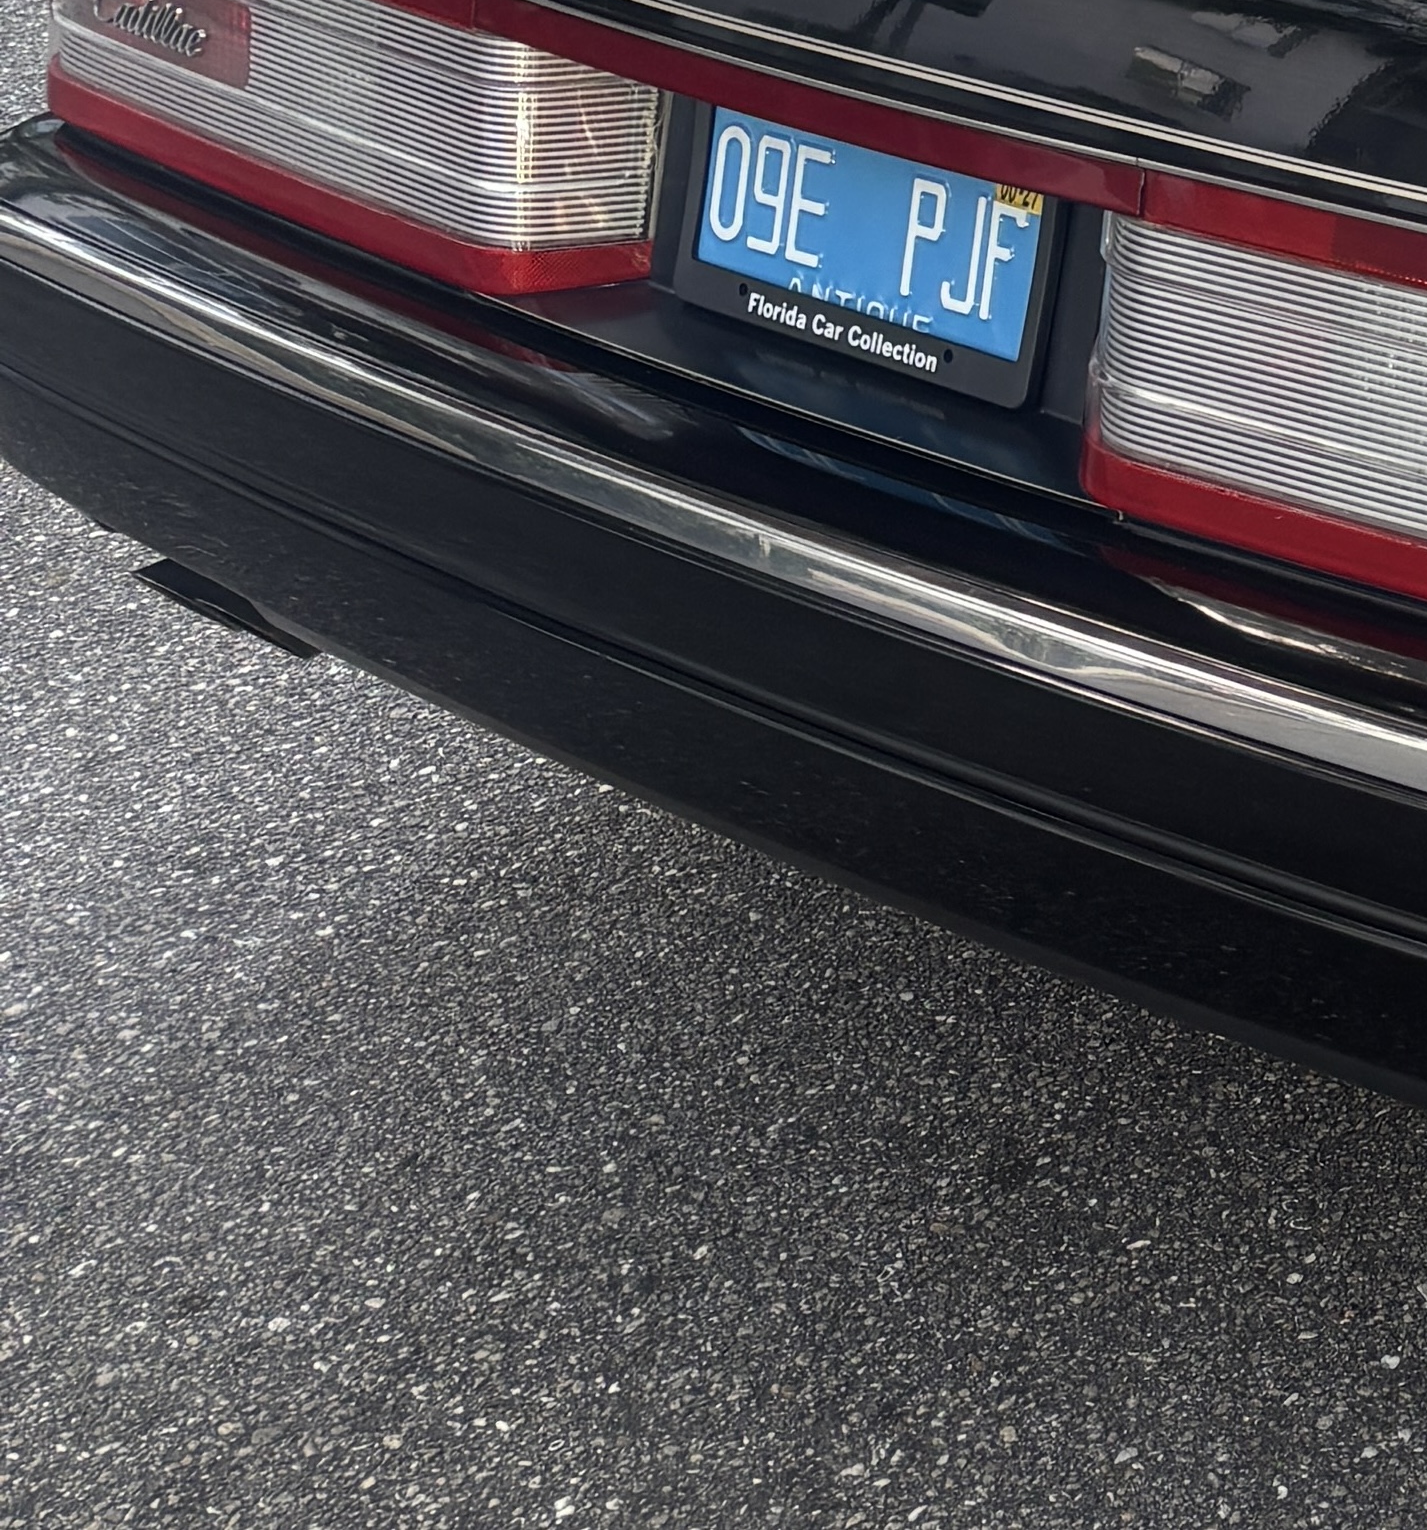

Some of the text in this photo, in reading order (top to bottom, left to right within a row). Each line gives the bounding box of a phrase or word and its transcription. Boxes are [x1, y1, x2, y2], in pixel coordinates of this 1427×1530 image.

[709, 125, 1029, 321] 09E PJF
[747, 292, 939, 372] Florida Car Collection
